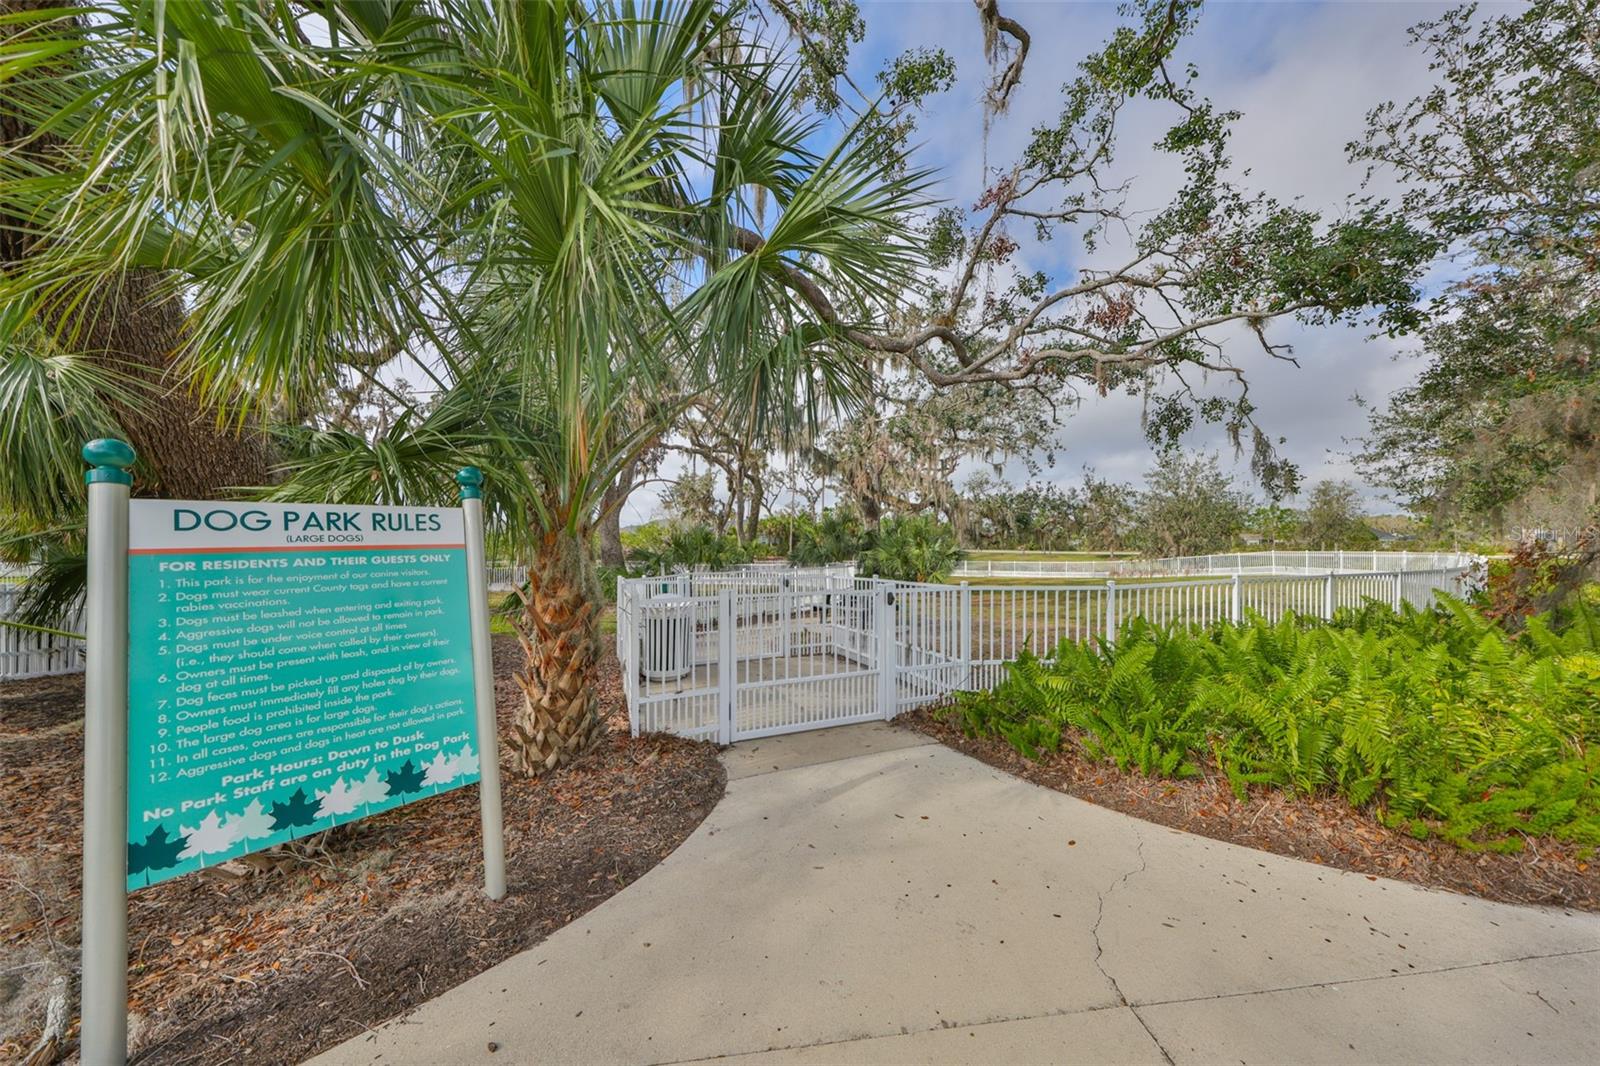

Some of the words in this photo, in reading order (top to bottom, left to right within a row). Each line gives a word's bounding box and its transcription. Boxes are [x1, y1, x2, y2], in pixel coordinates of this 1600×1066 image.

[174, 509, 272, 531] DOG
[283, 511, 362, 531] PARK
[372, 513, 441, 532] RULES
[286, 534, 324, 542] (LARGE
[159, 561, 196, 572] FOR
[202, 558, 288, 570] RESIDENTS
[293, 558, 326, 567] AND
[330, 556, 368, 566] THEIR
[371, 555, 417, 564] GUESTS
[420, 554, 450, 562] ONLY
[158, 592, 170, 602] 2.
[176, 592, 208, 602] Dogs
[212, 590, 238, 599] must
[274, 586, 310, 595] current
[312, 584, 346, 592] County
[371, 580, 388, 588] and
[391, 579, 411, 588] have
[160, 580, 171, 589] 1.
[176, 578, 200, 588] This
[204, 576, 231, 589] park
[236, 576, 244, 585] is
[247, 574, 264, 584] for
[266, 574, 283, 582] the
[286, 572, 338, 583] enjoyment
[370, 569, 399, 578] canine
[158, 618, 171, 628] 3.
[176, 617, 208, 626] Dogs
[212, 614, 239, 622] must
[243, 612, 256, 620] be
[261, 608, 302, 618] leashed
[304, 606, 332, 614] when
[334, 604, 372, 612] entering
[374, 601, 392, 610] and
[176, 602, 214, 612] rabies
[218, 599, 289, 609] vaccinations.
[158, 632, 170, 640] 4.
[176, 626, 243, 640] Aggressive
[247, 624, 274, 634] dogs
[277, 620, 296, 628] will
[299, 620, 314, 628] not
[318, 618, 330, 626] be
[333, 614, 369, 624] allowed
[384, 610, 412, 620] remain
[158, 646, 171, 656] 5.
[176, 644, 208, 654] Dogs
[212, 640, 240, 649] must
[243, 637, 257, 646] be
[261, 634, 292, 643] under
[296, 631, 322, 640] voice
[325, 626, 358, 636] control
[372, 623, 383, 632] all
[209, 652, 234, 662] they
[238, 646, 274, 658] should
[278, 646, 306, 654] come
[310, 641, 336, 650] when
[339, 636, 367, 647] called
[370, 635, 380, 644] by
[384, 632, 402, 642] their
[158, 674, 171, 683] 6.
[176, 668, 225, 680] Owners
[230, 664, 256, 673] must
[260, 660, 273, 670] be
[276, 656, 315, 670] present
[318, 652, 338, 661] with
[371, 646, 388, 655] and
[158, 700, 171, 710] 7.
[176, 697, 204, 706] Dog
[208, 692, 238, 702] feces
[242, 686, 267, 696] must
[271, 682, 285, 692] be
[288, 676, 321, 692] picked
[340, 670, 359, 680] and
[362, 664, 401, 677] disposed
[403, 662, 412, 670] of
[414, 662, 424, 670] by
[176, 682, 202, 692] dog
[206, 680, 218, 688] at
[221, 676, 236, 686] all
[240, 674, 272, 684] times.
[158, 714, 171, 724] 8.
[176, 707, 226, 720] Owners
[230, 700, 256, 711] must
[260, 688, 324, 706] immediately
[327, 685, 338, 694] fill
[362, 680, 385, 688] holes
[388, 676, 404, 684] dug
[407, 674, 417, 682] by
[158, 728, 171, 738] 9.
[176, 720, 219, 734] People
[223, 712, 250, 726] food
[266, 701, 320, 720] prohibited
[324, 696, 352, 708] inside
[356, 694, 370, 702] the
[150, 743, 171, 754] 10.
[176, 738, 199, 748] The
[204, 732, 236, 744] large
[239, 726, 262, 736] dog
[266, 722, 291, 732] area
[306, 714, 320, 723] for
[324, 710, 349, 720] large
[150, 758, 171, 768] 11.
[176, 754, 188, 763] In
[192, 748, 208, 760] all
[212, 744, 248, 756] cases,
[252, 734, 293, 747] owners
[296, 730, 314, 738] are
[317, 716, 371, 734] responsible
[374, 713, 386, 722] for
[389, 709, 409, 718] their
[410, 704, 433, 714] dog's
[150, 772, 170, 784] 12.
[176, 757, 246, 778] Aggressive
[249, 751, 278, 762] dogs
[280, 743, 302, 755] and
[305, 739, 330, 749] dogs
[344, 730, 366, 740] heat
[368, 727, 384, 735] are
[386, 722, 400, 730] not
[402, 714, 435, 728] allowed
[222, 768, 264, 787] Park
[270, 756, 323, 775] Hours:
[328, 744, 370, 761] Dawn
[374, 741, 389, 750] to
[393, 730, 424, 745] Dusk
[143, 808, 174, 822] No
[181, 792, 226, 812] Park
[233, 778, 274, 799] Staff
[280, 774, 308, 786] are
[312, 768, 332, 778] on
[337, 758, 369, 772] duty
[374, 753, 386, 762] in
[390, 748, 411, 758] the
[415, 742, 439, 752] Dog
[443, 732, 470, 744] Park
